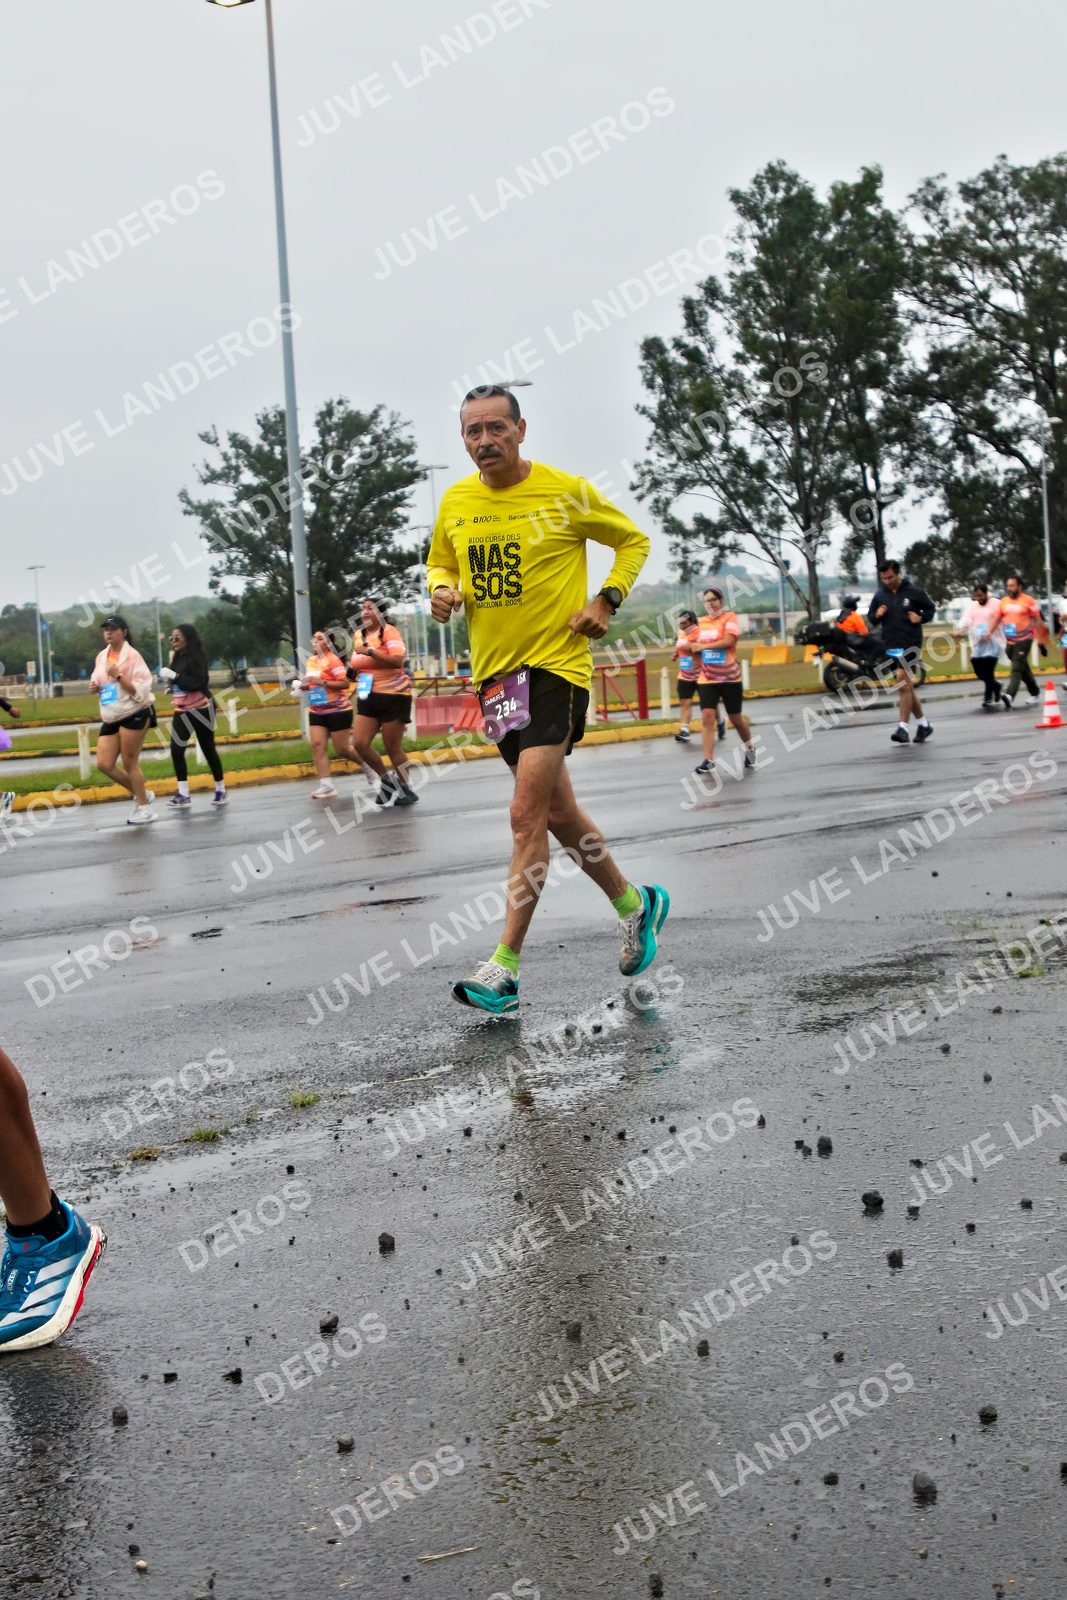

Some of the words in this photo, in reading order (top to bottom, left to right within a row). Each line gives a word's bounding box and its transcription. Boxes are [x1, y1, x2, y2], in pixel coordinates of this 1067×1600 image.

[485, 534, 505, 543] CURSA
[506, 533, 521, 541] DELS
[468, 542, 520, 573] NAS
[472, 570, 522, 601] SOS
[517, 671, 527, 685] 15K
[495, 697, 517, 720] 234
